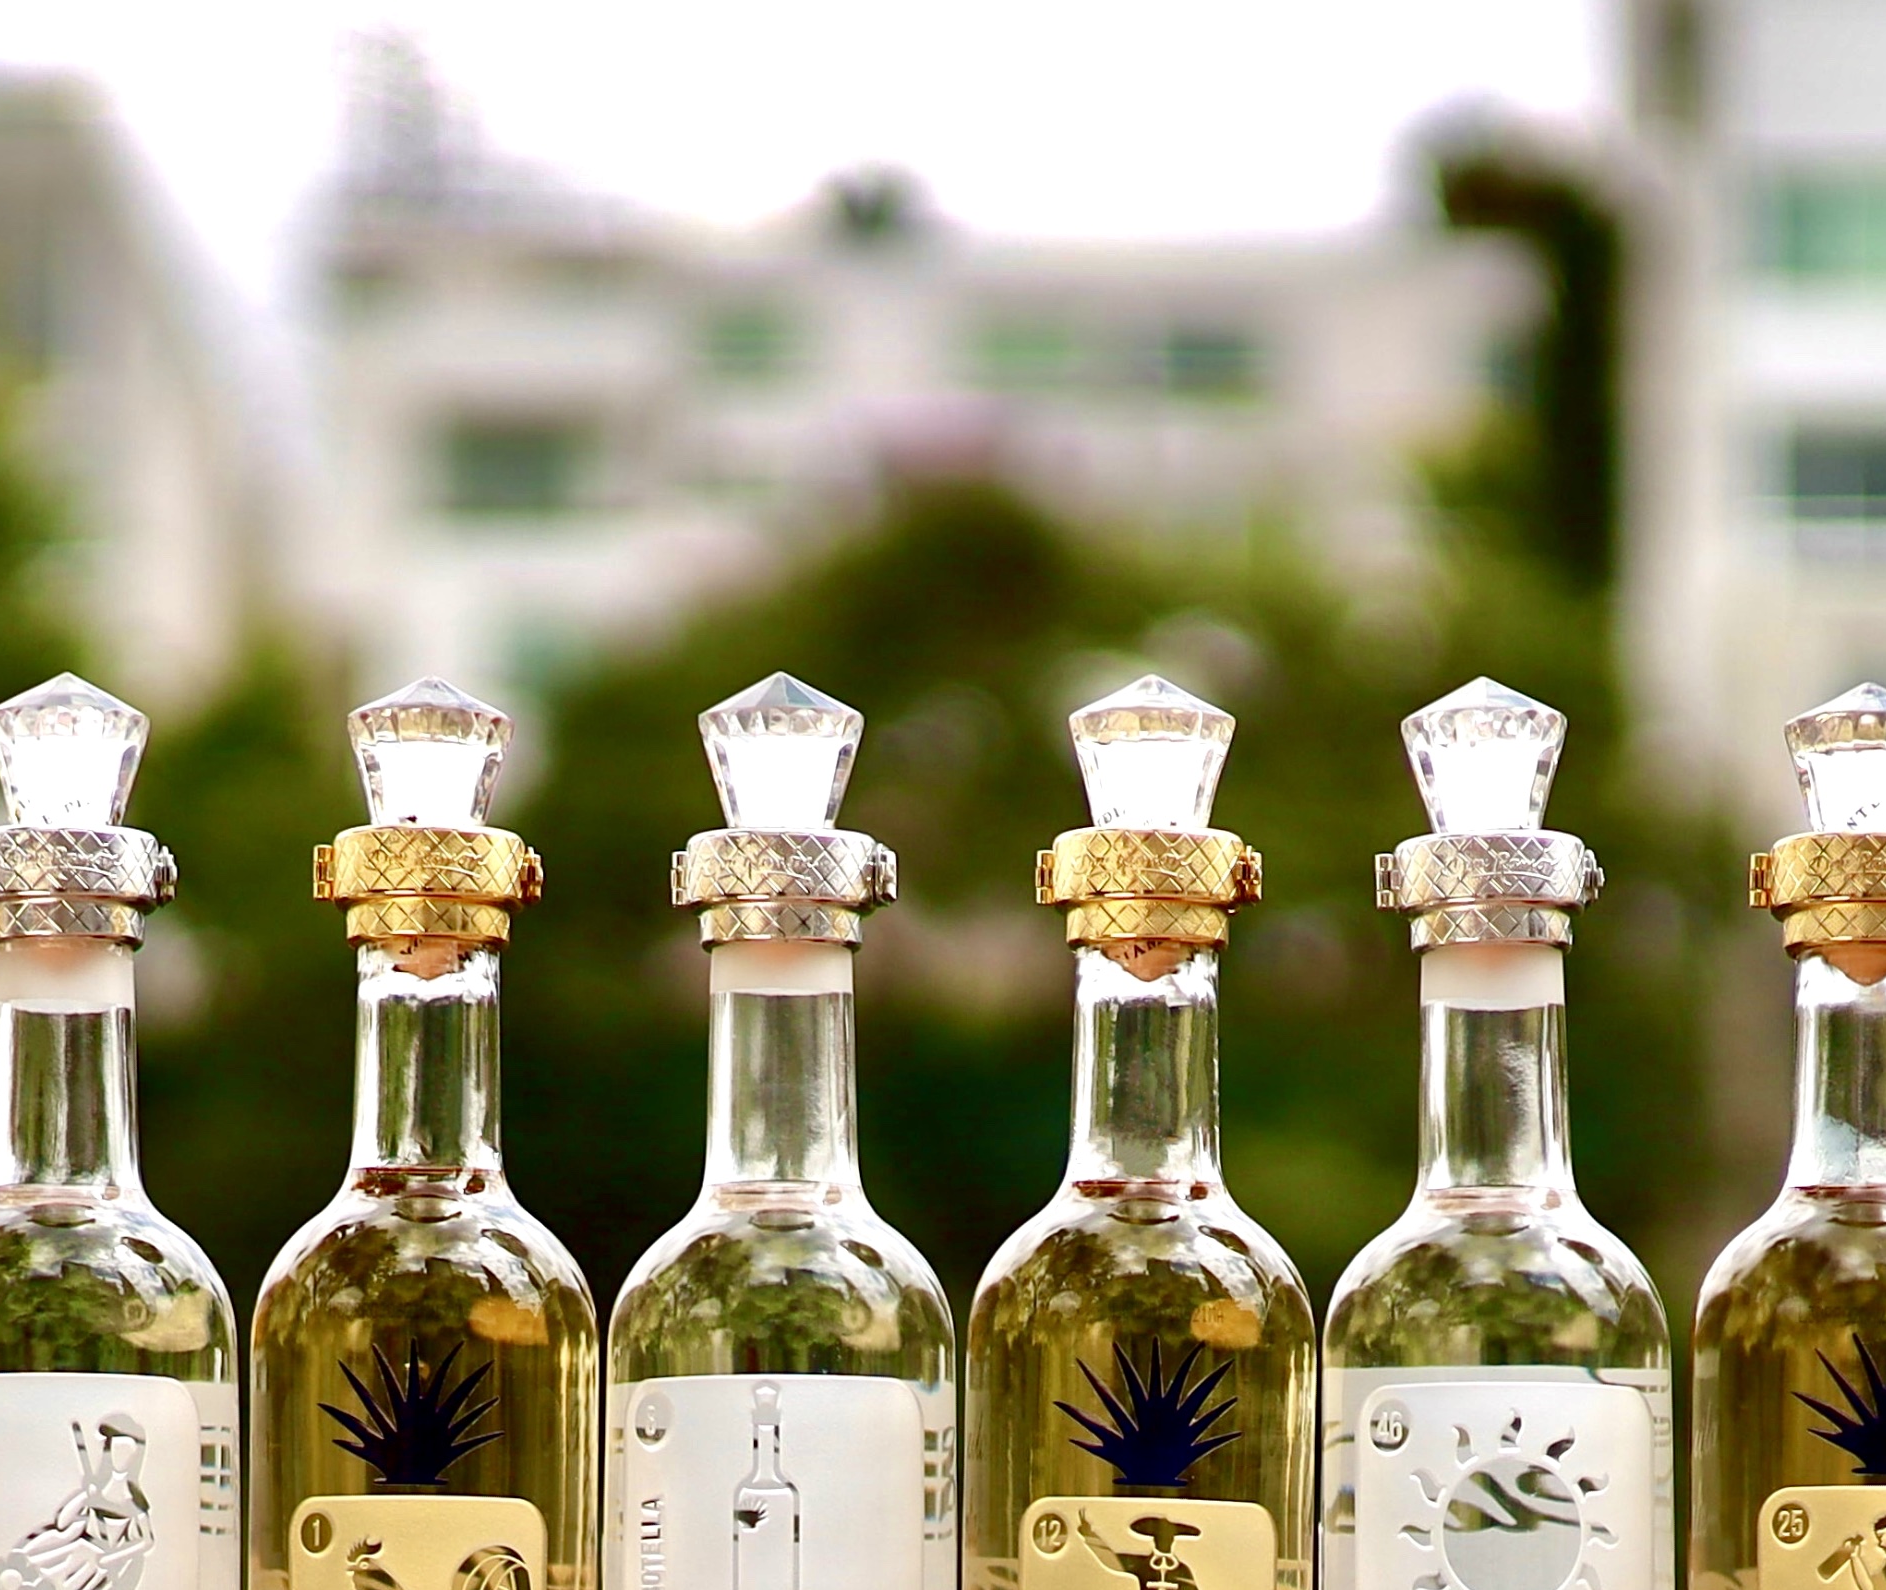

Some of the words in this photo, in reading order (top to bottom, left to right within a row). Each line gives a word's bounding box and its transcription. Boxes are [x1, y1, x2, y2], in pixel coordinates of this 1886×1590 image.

[1375, 1410, 1404, 1441] 46
[311, 1518, 321, 1547] 1
[1038, 1518, 1063, 1548] 12
[1777, 1509, 1805, 1538] 25
